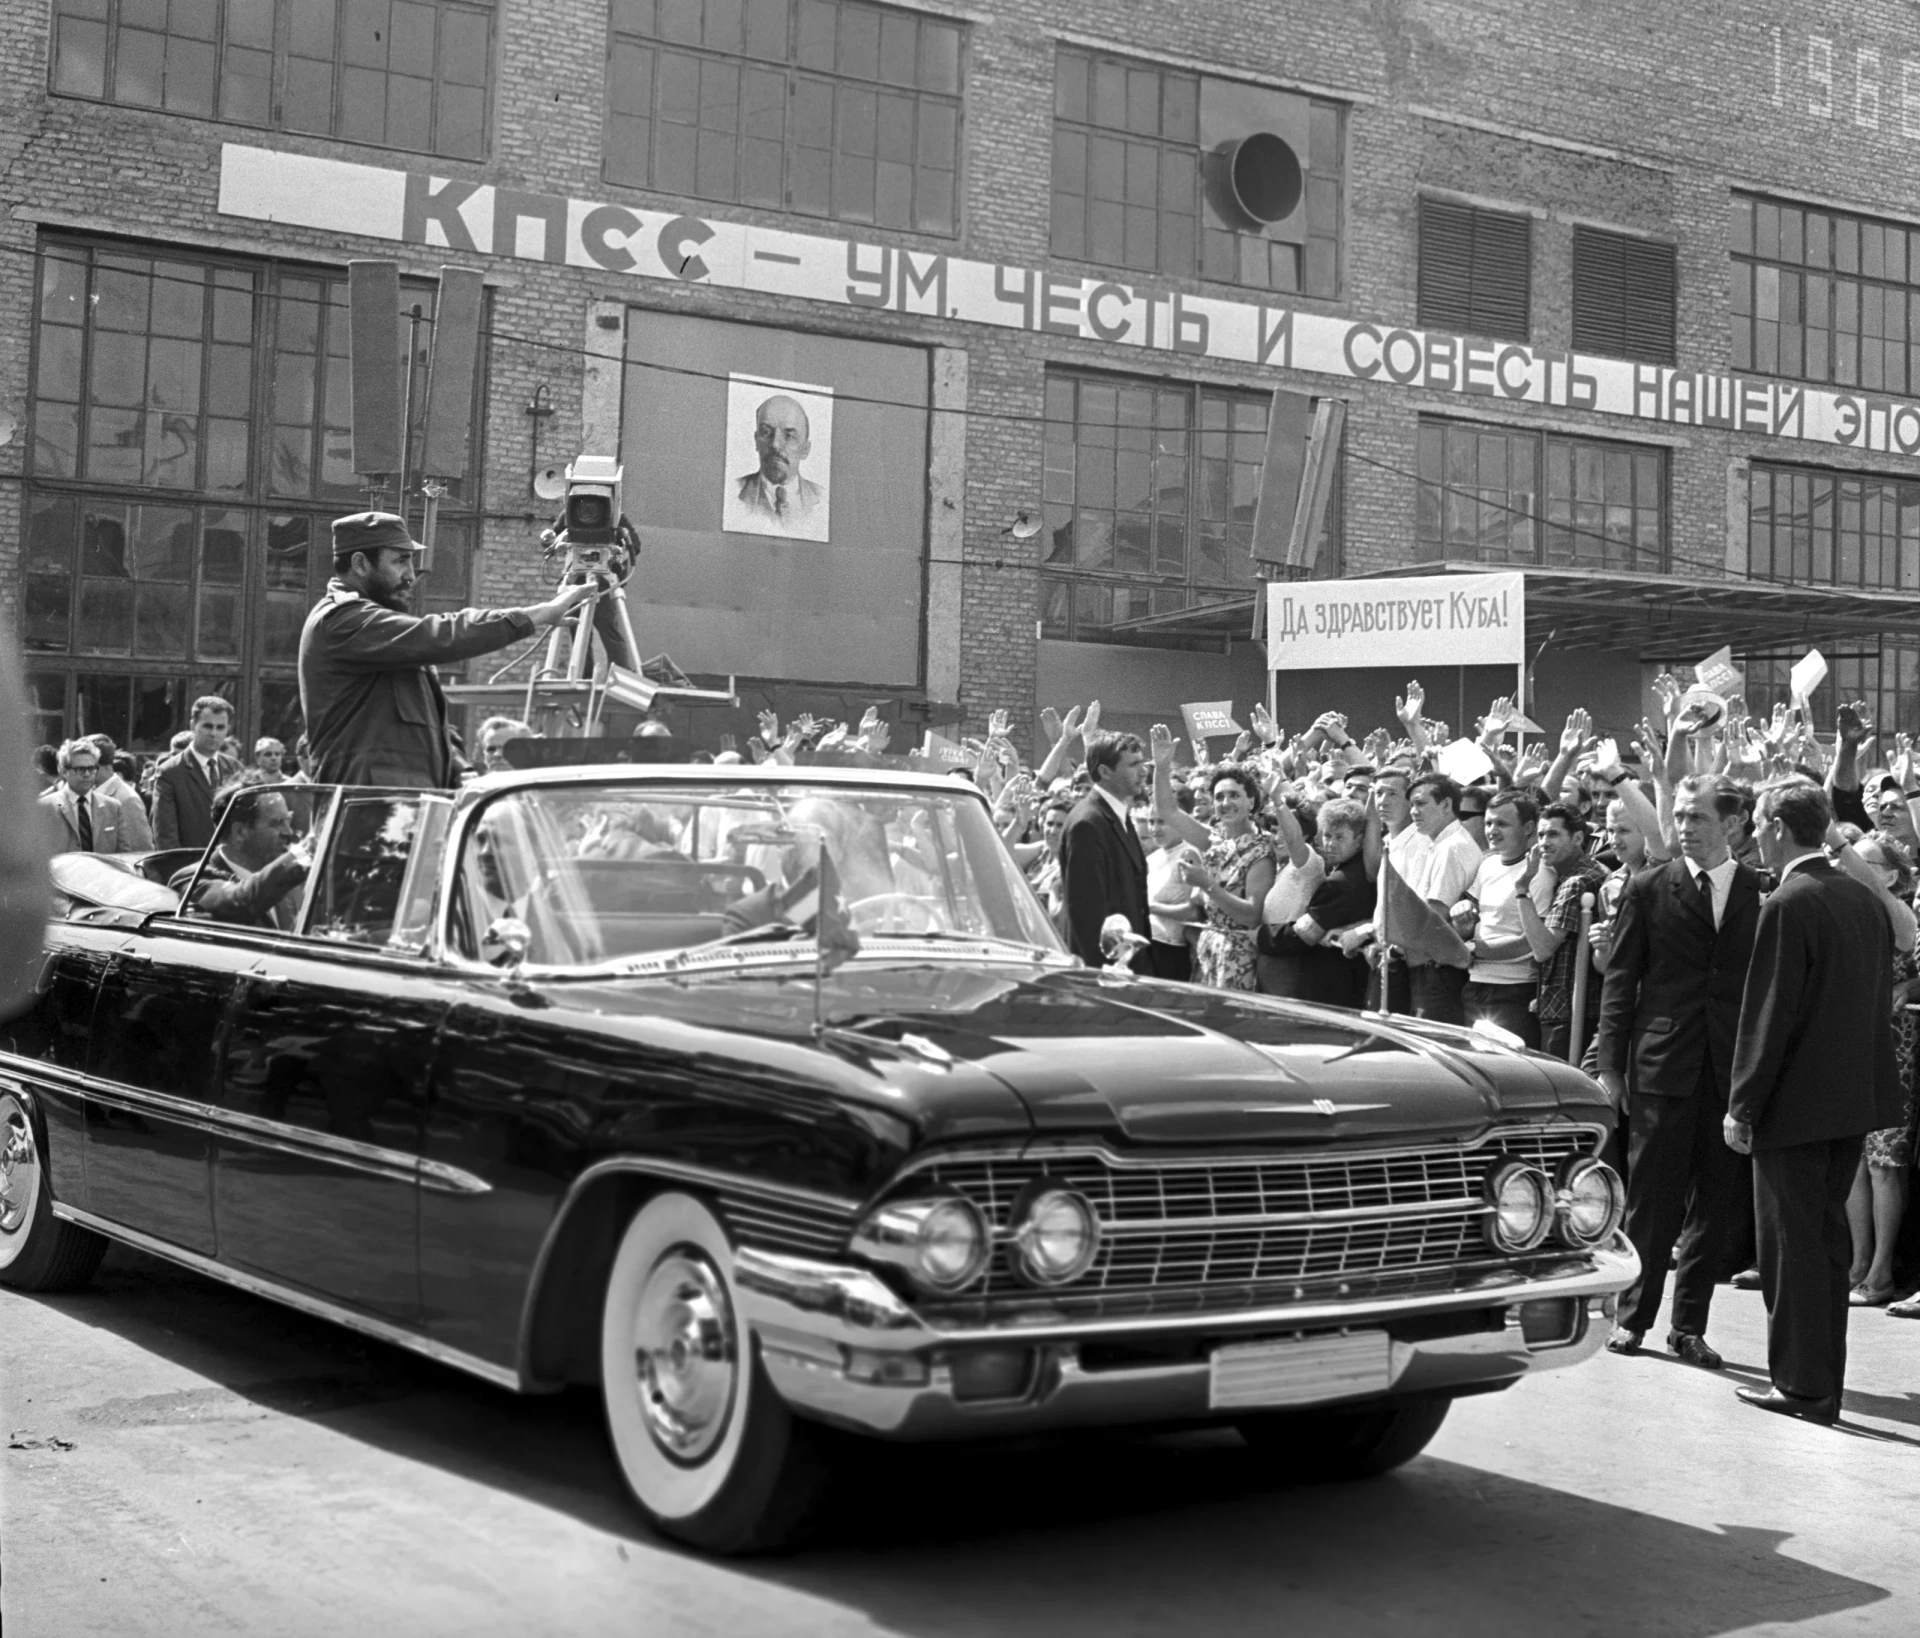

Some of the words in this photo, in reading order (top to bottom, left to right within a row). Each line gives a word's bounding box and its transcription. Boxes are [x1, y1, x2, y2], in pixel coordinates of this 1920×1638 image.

[403, 173, 716, 282] КПСС
[846, 241, 959, 318] УМ,
[994, 264, 1210, 356] ЧЕСТЬ
[1257, 305, 1295, 369] И
[1343, 322, 1599, 412] СОВЕСТЬ
[1633, 363, 1804, 438] НАШЕЙ
[1193, 711, 1226, 721] СЛАВА
[1196, 718, 1231, 730] КПСС!
